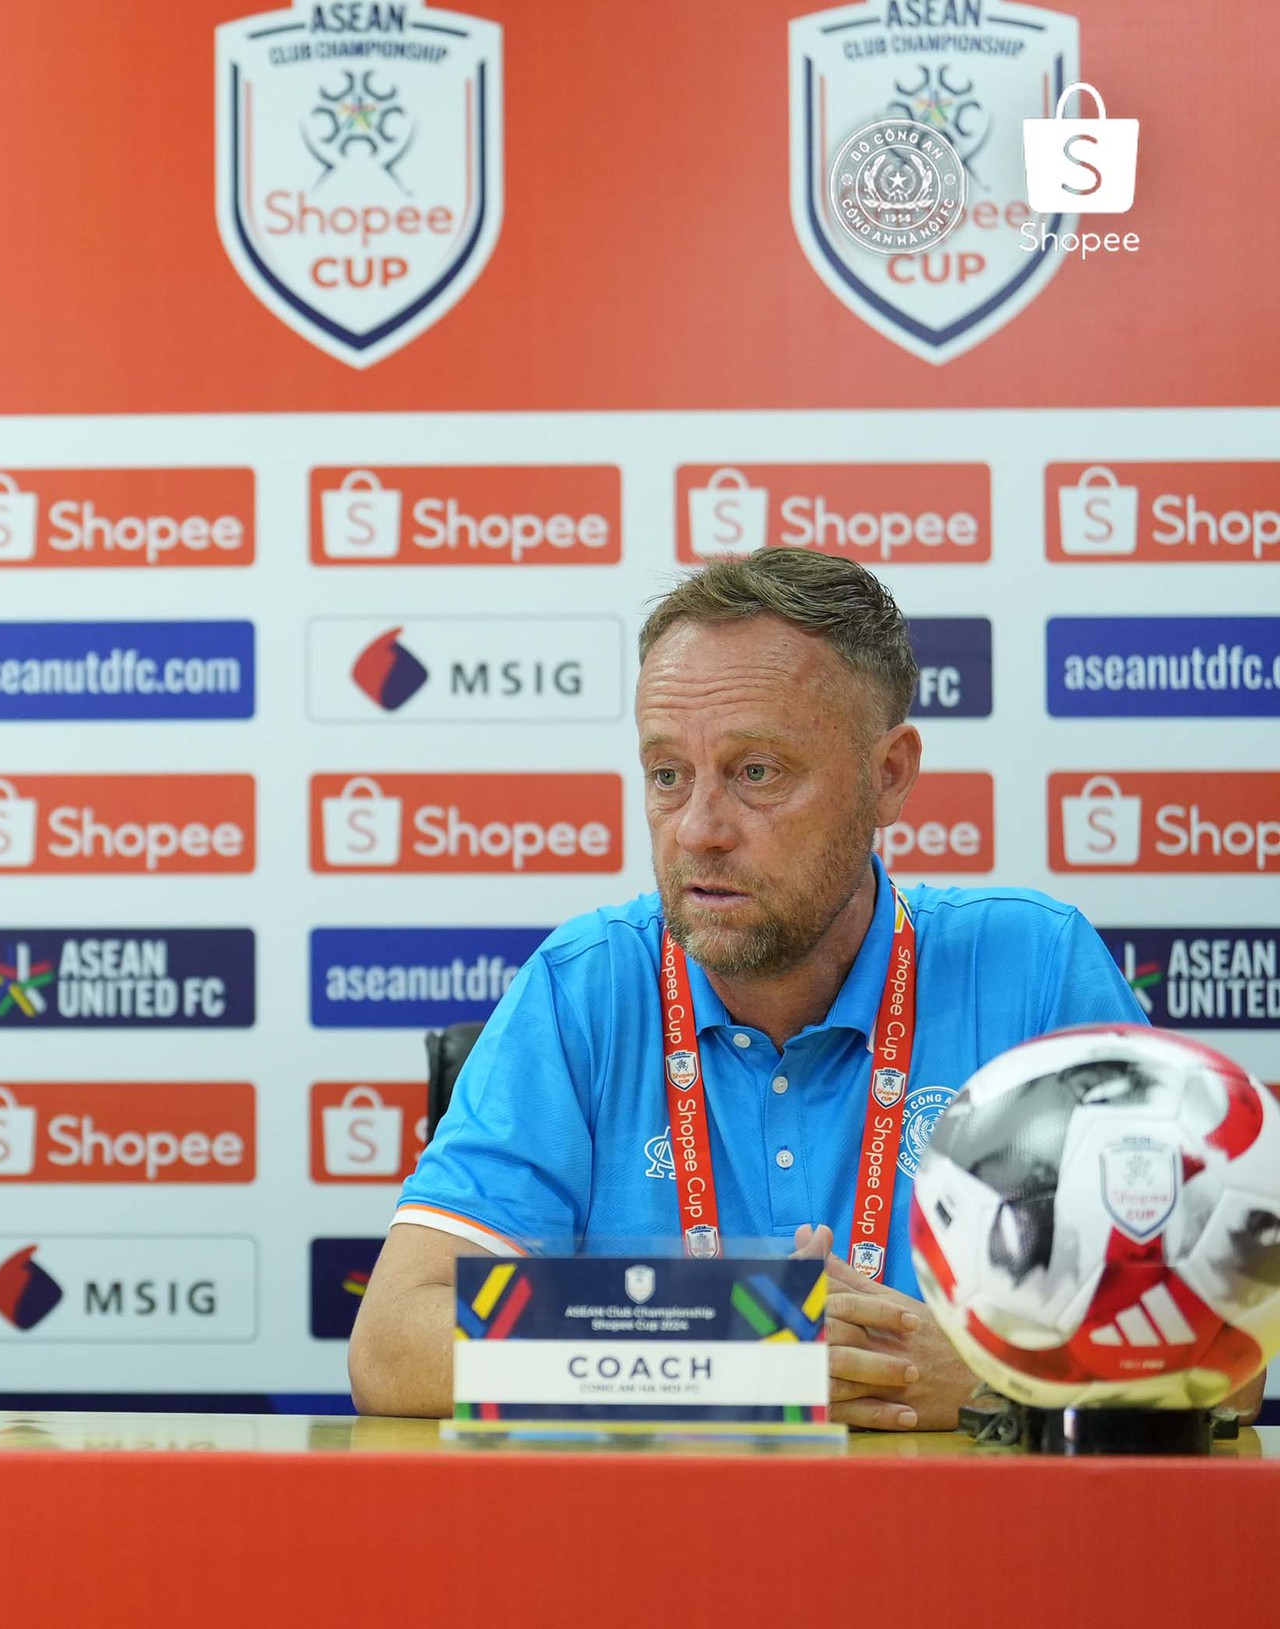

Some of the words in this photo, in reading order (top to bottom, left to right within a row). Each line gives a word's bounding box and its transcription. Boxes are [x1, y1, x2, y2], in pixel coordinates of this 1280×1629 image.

[311, 2, 405, 35] ASEAN
[885, 0, 981, 28] ASEAN
[269, 43, 312, 67] CLUB
[316, 40, 448, 66] CHAMPIONSHIP
[844, 37, 888, 61] CLUB
[891, 33, 1025, 59] CHAMPIONSHIP
[264, 190, 453, 248] Shopee
[310, 257, 408, 289] CUP
[887, 252, 986, 285] CUP
[48, 501, 243, 562] Shopee
[413, 499, 609, 561] Shopee
[781, 496, 977, 559] Shopee
[451, 661, 583, 697] MSIG
[920, 668, 960, 707] FC
[48, 808, 244, 870] Shopee
[413, 806, 610, 870] Shopee
[59, 941, 167, 977] ASEAN
[1167, 939, 1276, 979] ASEAN
[58, 980, 179, 1018] UNITED
[184, 979, 225, 1018] FC
[890, 946, 911, 1016] Shopee
[1166, 979, 1280, 1018] UNITED
[667, 1004, 685, 1045] Cup
[879, 1021, 905, 1061] Cup
[911, 1094, 942, 1109] CÔNG
[47, 1115, 244, 1179] Shopee
[676, 1098, 697, 1172] Shopee
[864, 1115, 893, 1189] Shopee
[684, 1177, 706, 1218] Cup
[854, 1194, 883, 1235] Cup
[85, 1281, 217, 1316] MSIG
[568, 1357, 711, 1379] COACH
